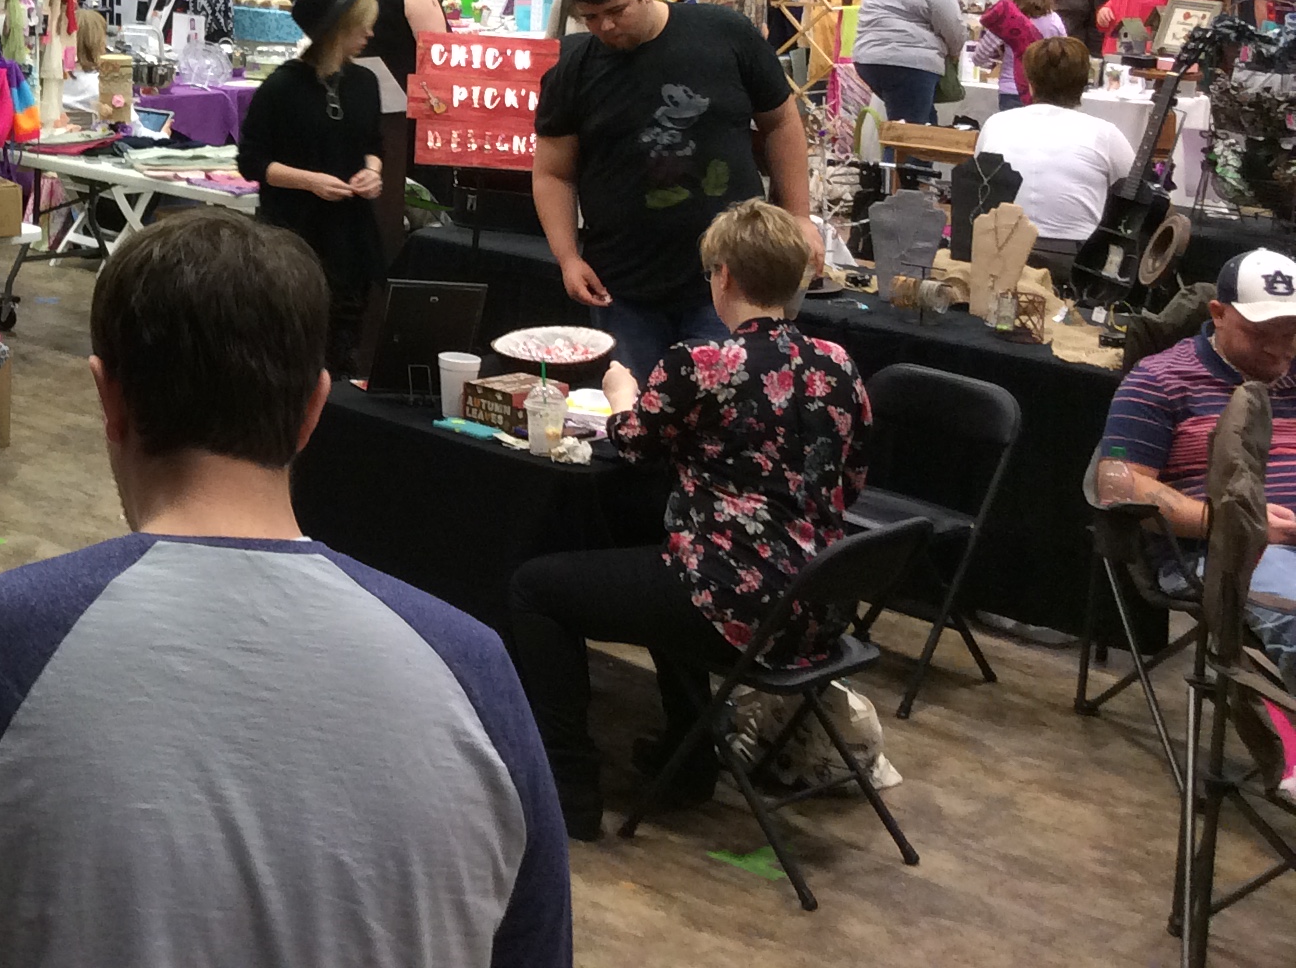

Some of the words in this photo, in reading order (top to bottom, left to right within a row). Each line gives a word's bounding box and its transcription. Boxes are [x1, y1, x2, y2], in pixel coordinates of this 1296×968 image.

[430, 43, 532, 71] CHIC'N
[465, 406, 504, 426] LEAVES
[466, 394, 512, 416] AUTUMN
